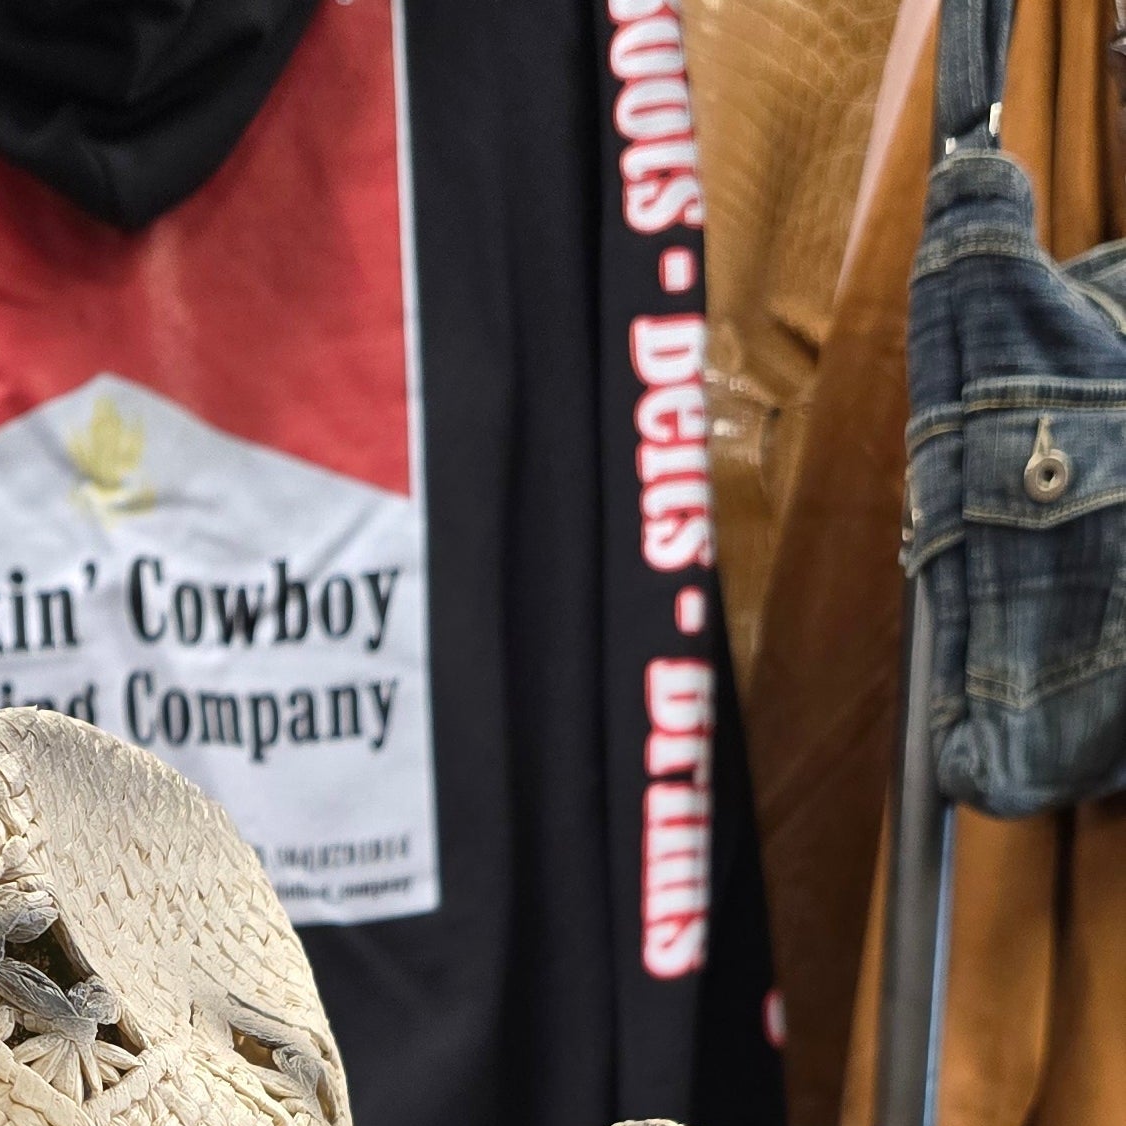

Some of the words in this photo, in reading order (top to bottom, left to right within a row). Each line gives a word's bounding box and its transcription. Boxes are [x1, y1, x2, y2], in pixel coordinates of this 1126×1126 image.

[629, 313, 716, 573] Belts
[127, 555, 398, 651] Cowboy
[124, 671, 397, 760] Company
